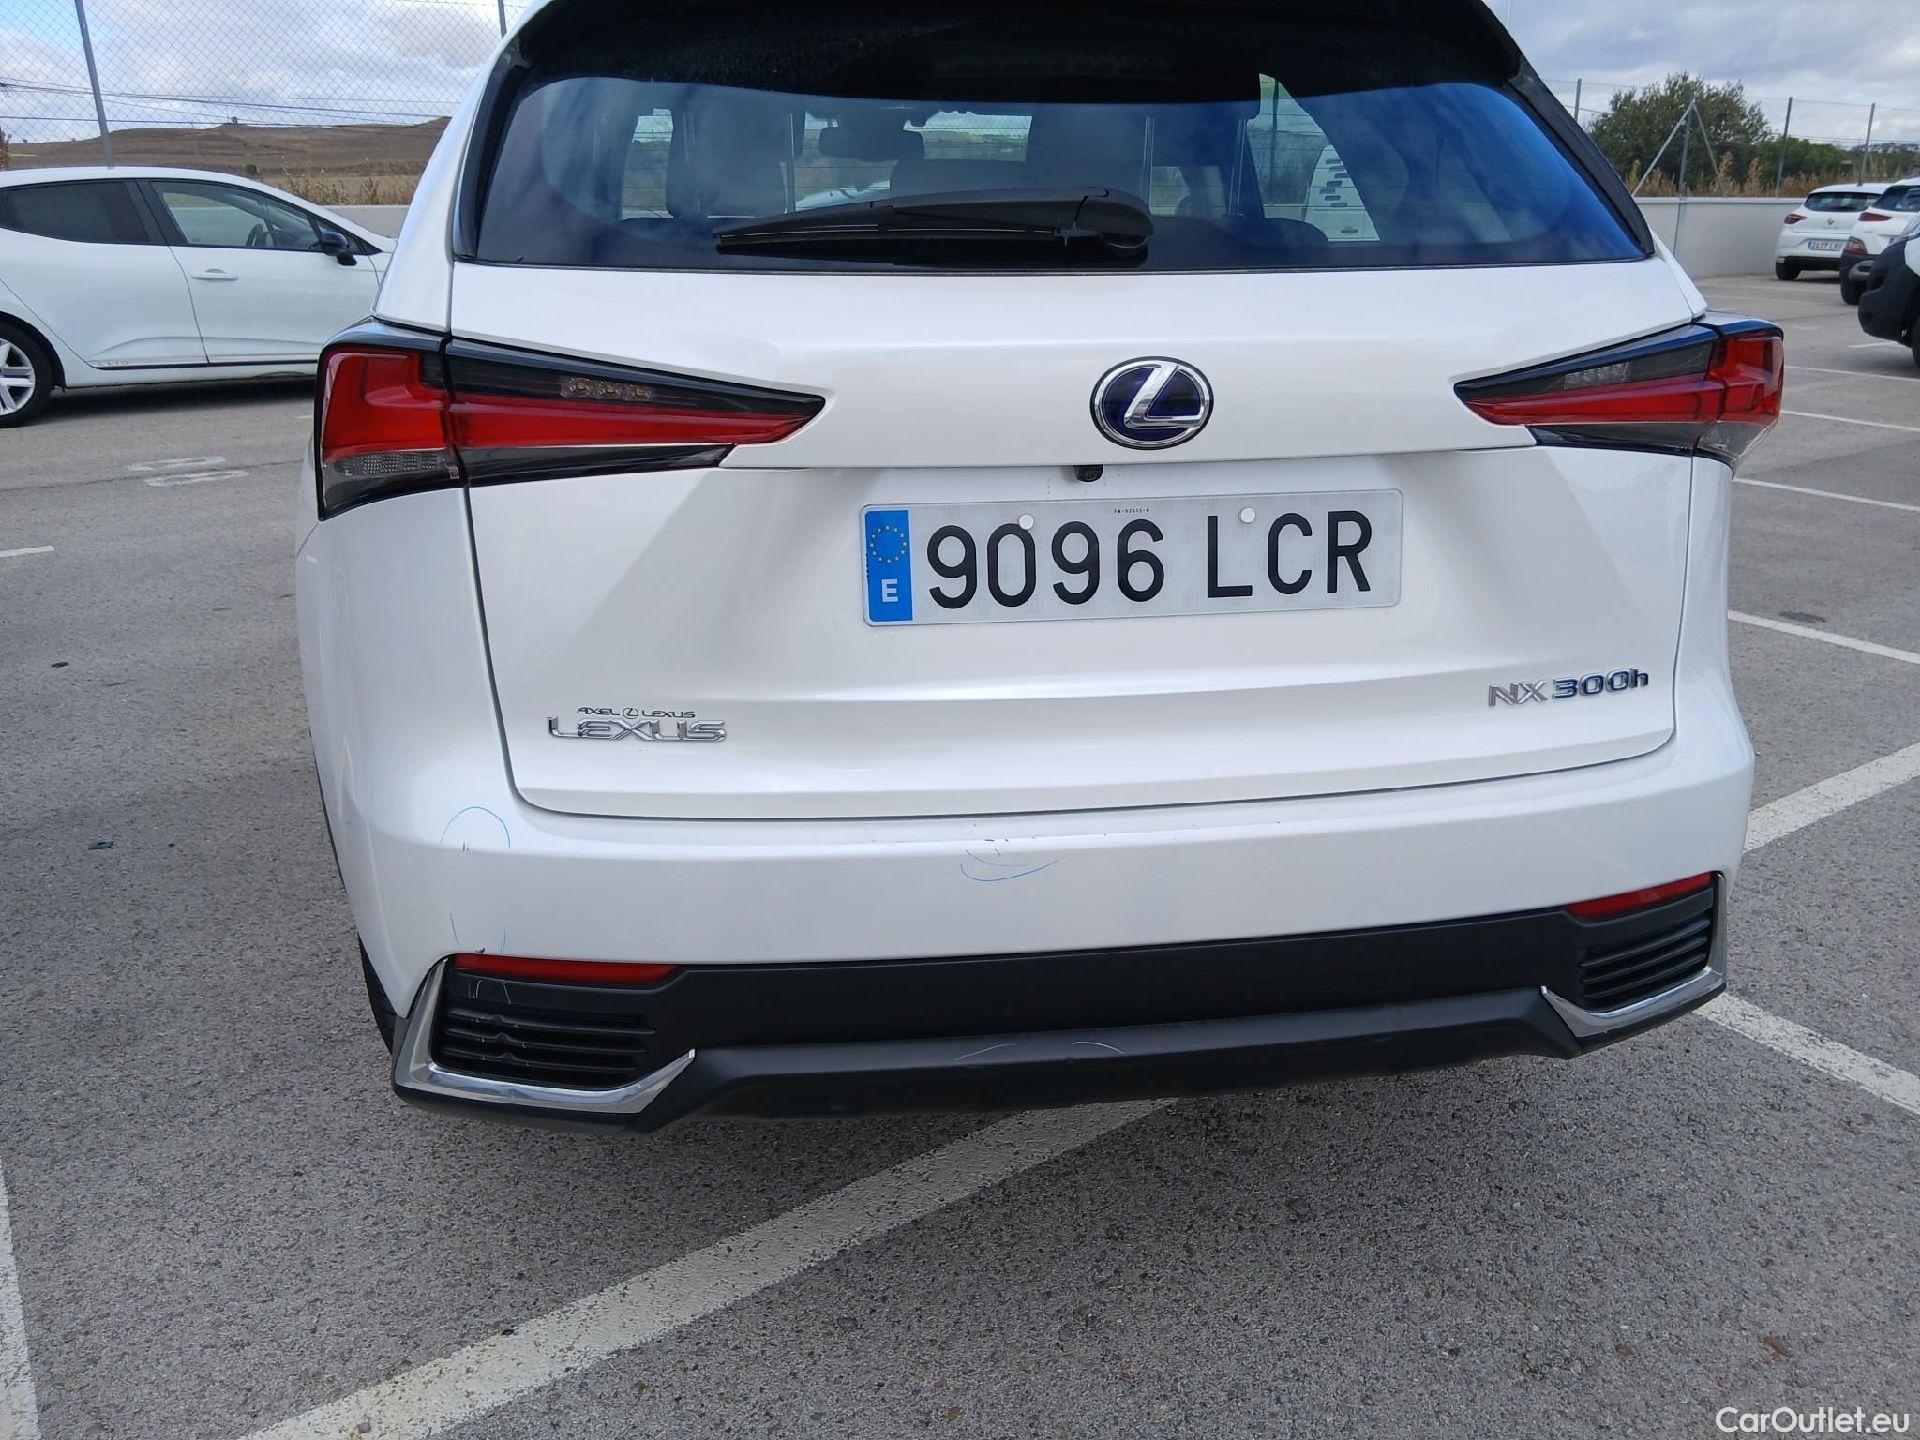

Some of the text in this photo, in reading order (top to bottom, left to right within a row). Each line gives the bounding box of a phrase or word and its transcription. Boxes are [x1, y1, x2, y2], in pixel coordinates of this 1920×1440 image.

[926, 510, 1372, 609] 9096 LCR
[881, 578, 898, 603] E
[1488, 668, 1649, 707] NX 300h
[577, 707, 696, 718] AXEL LEXUS
[548, 716, 727, 742] LEXUS
